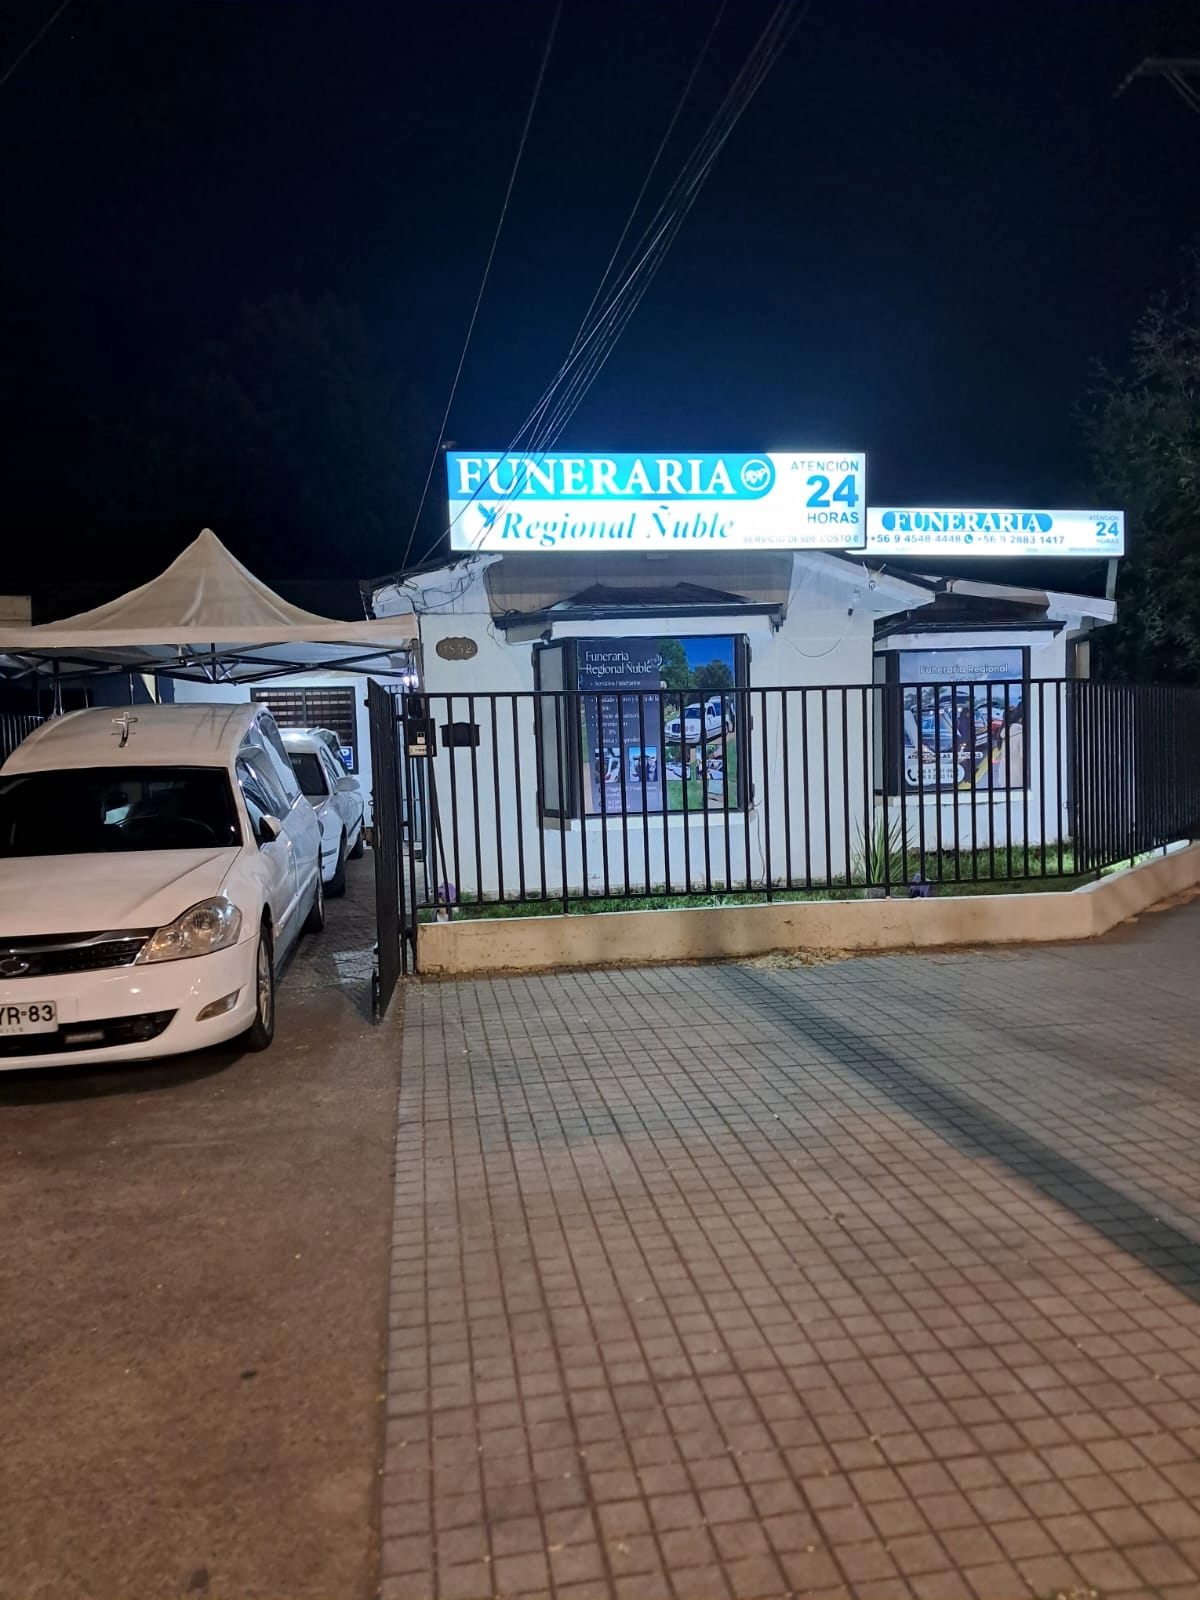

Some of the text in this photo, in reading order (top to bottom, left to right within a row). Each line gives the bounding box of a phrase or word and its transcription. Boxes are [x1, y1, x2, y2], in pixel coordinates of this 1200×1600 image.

[790, 457, 859, 472] ATENCIÓN
[455, 458, 736, 495] FUNERARIA
[805, 475, 859, 508] 24
[501, 505, 734, 546] Regional Ñuble
[807, 512, 859, 524] HORAS
[892, 511, 1042, 532] FUNERARIA
[1095, 521, 1119, 537] 24
[820, 534, 851, 543] COSTO
[870, 534, 890, 543] +56
[894, 534, 901, 543] 9
[1009, 535, 1036, 544] 2883
[1039, 535, 1065, 545] 1417
[585, 651, 629, 662] Funeraria
[586, 661, 652, 678] Regional Ñuble
[919, 664, 1008, 675] Funeraria Regional
